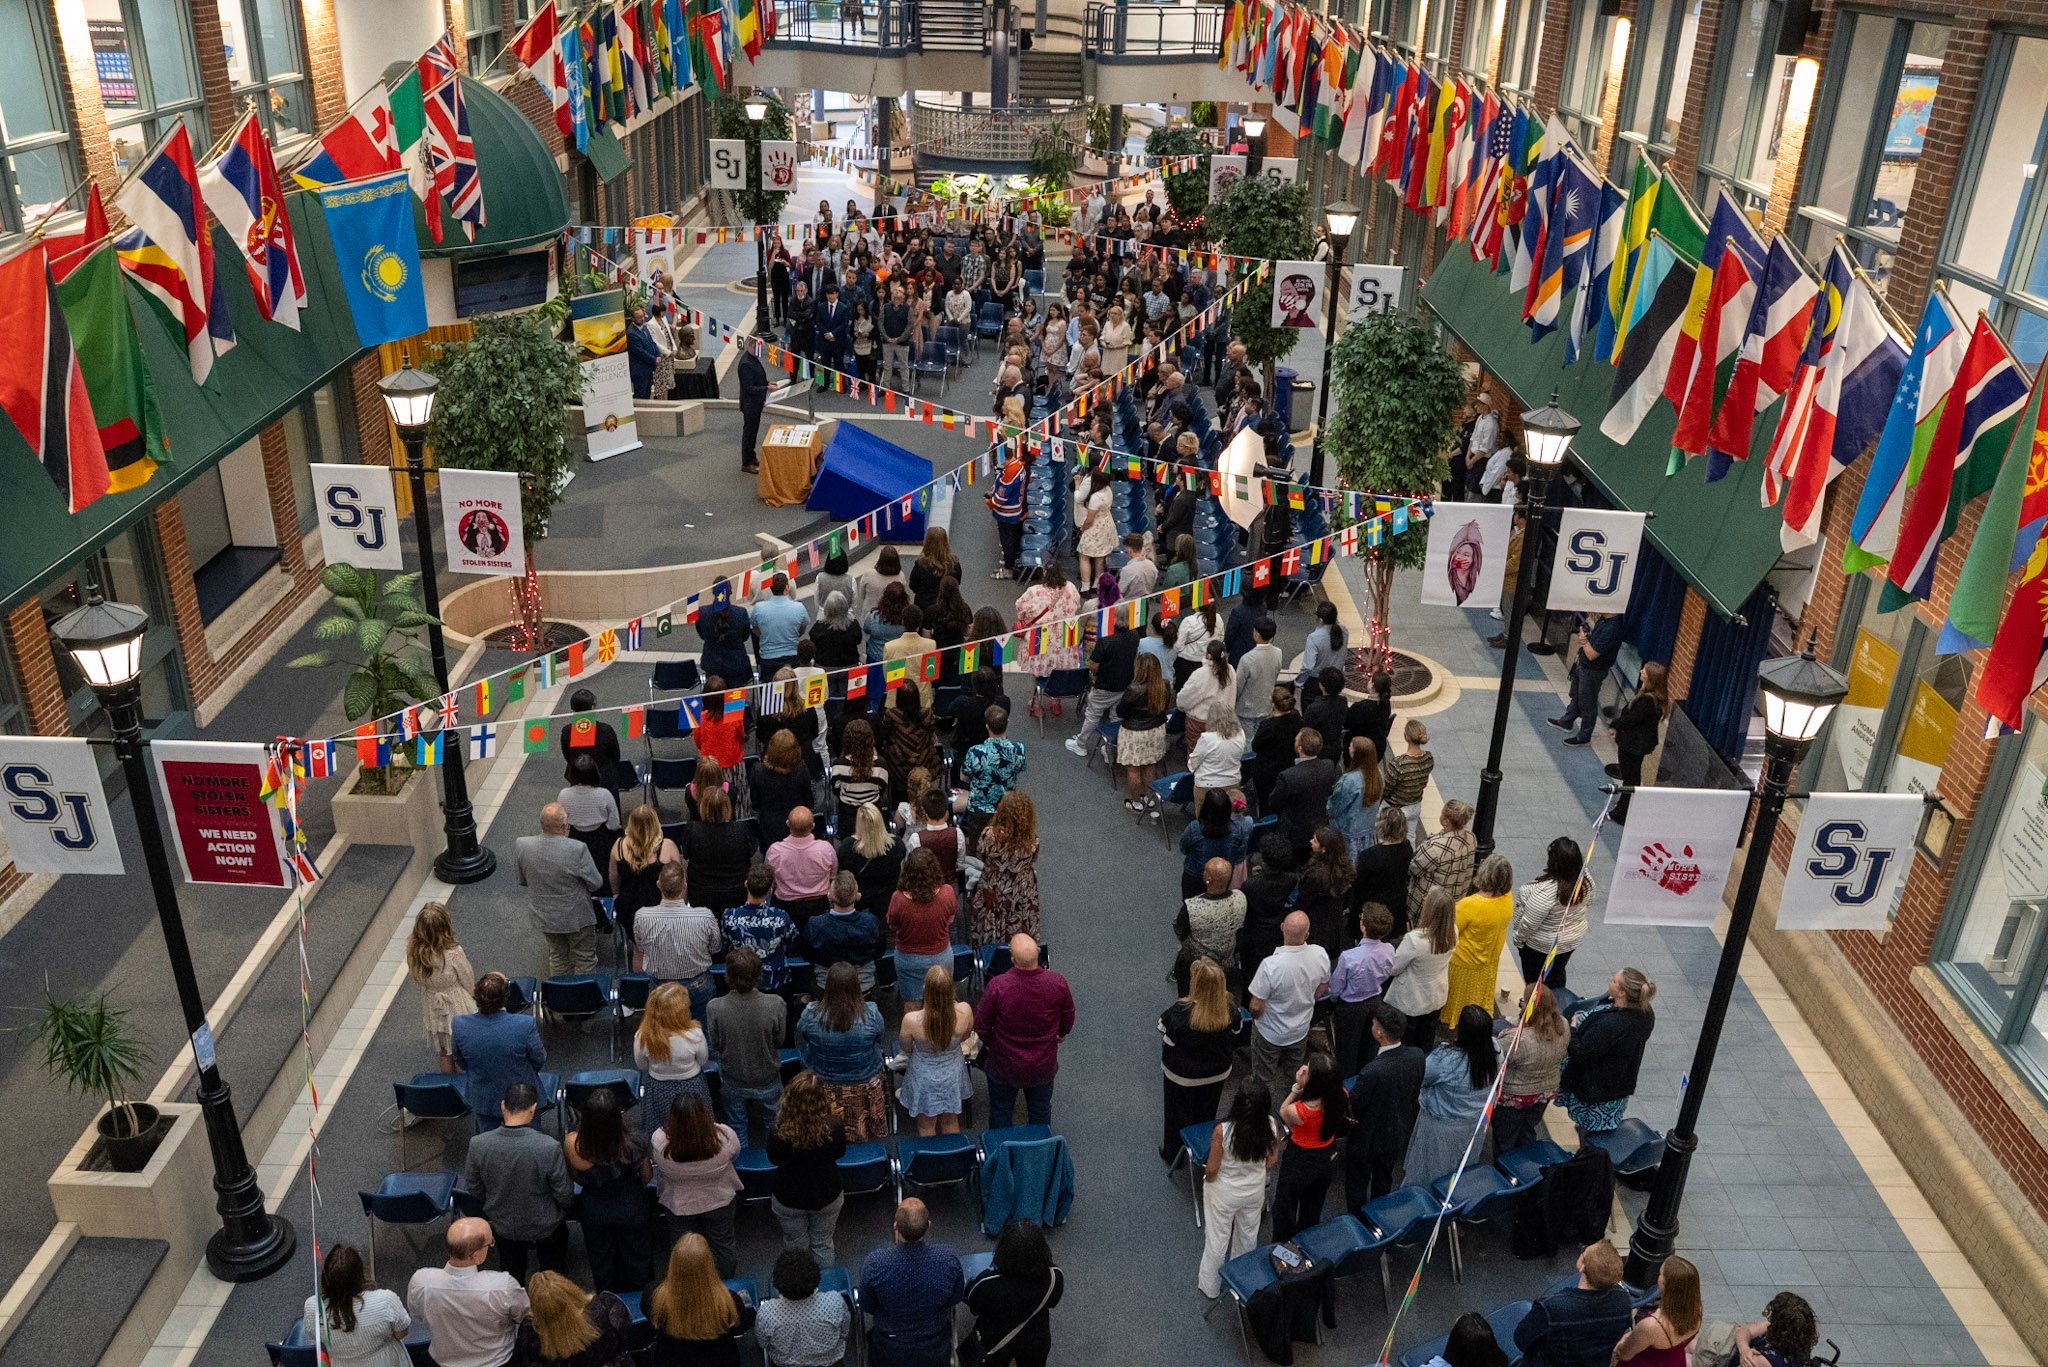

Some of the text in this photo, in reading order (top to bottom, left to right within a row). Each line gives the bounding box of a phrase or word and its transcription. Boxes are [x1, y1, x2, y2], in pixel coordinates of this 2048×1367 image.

[715, 149, 741, 179] SJ
[459, 499, 503, 510] NO MORE
[324, 483, 386, 551] SJ
[462, 559, 512, 568] STOLEN SISTERS
[1564, 528, 1629, 597] SJ
[181, 775, 250, 788] NO MORE
[191, 790, 246, 802] STOLEN
[0, 763, 99, 851] SJ
[195, 805, 250, 817] SISTERS
[198, 828, 257, 840] WE NEED
[207, 842, 256, 854] ACTION
[215, 856, 253, 867] NOW!
[1666, 862, 1695, 872] MORE
[1804, 819, 1896, 907] SJ
